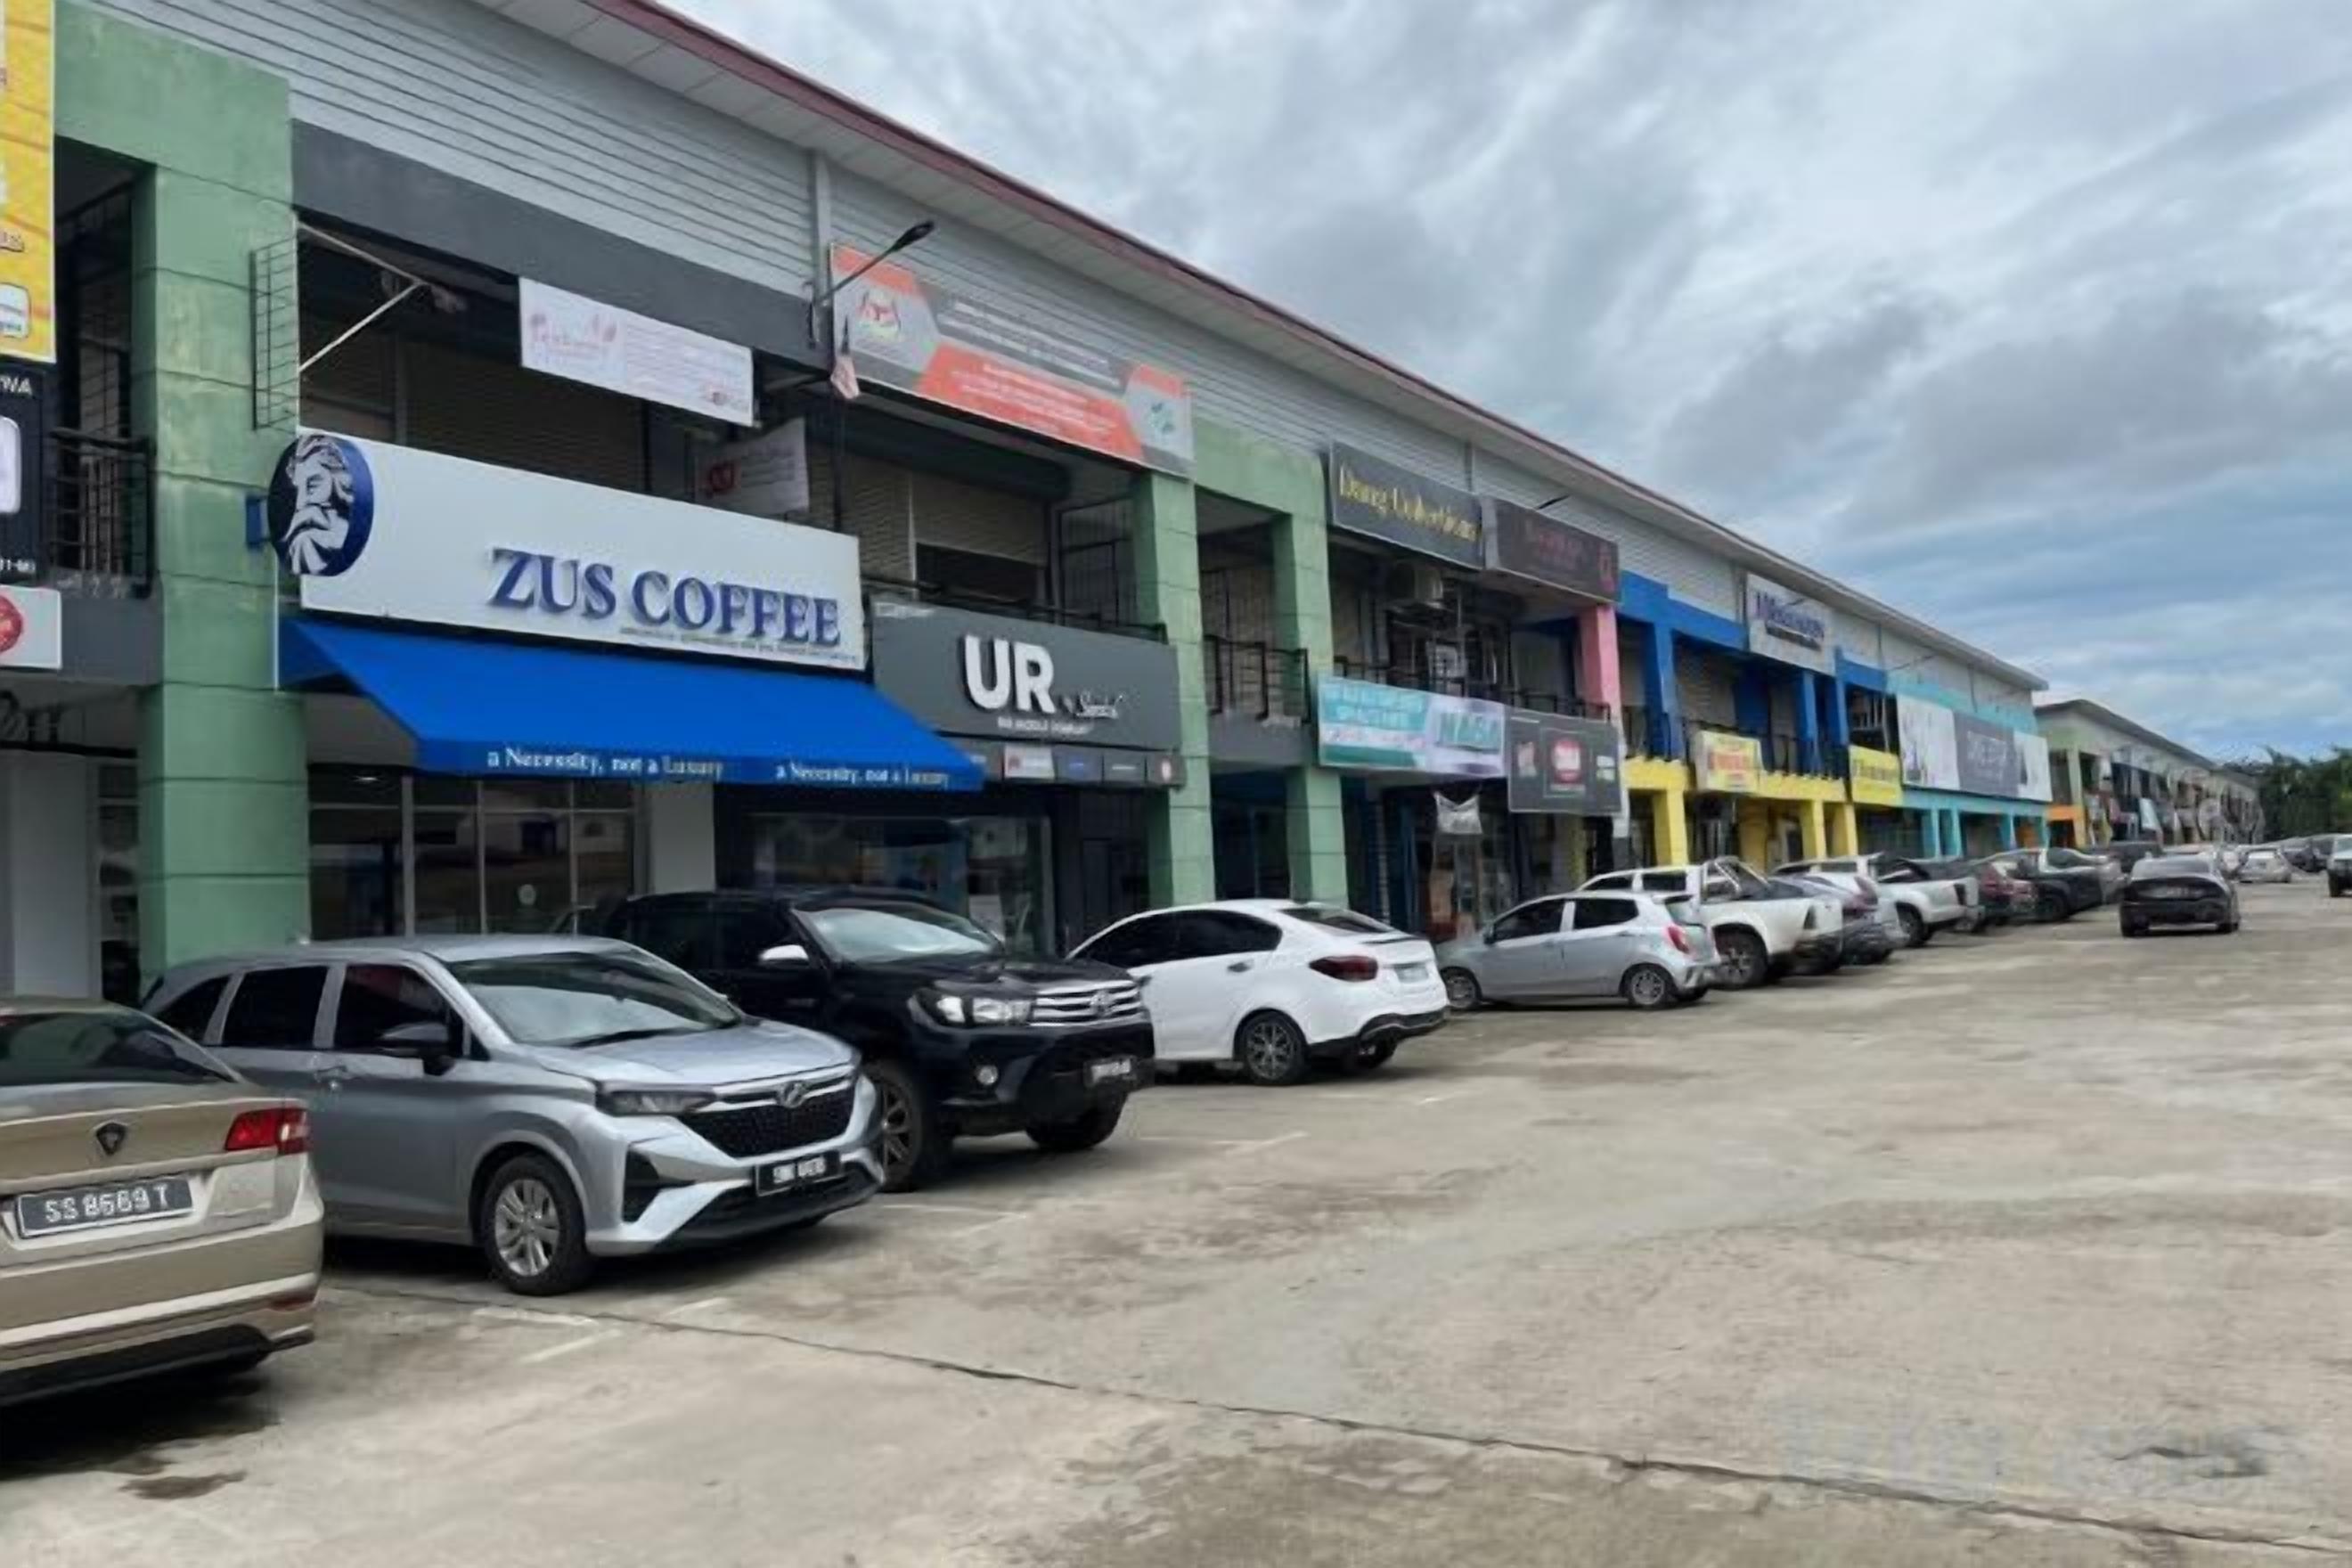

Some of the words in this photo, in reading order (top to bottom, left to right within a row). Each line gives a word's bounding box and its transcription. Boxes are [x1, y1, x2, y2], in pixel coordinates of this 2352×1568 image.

[487, 548, 617, 619] ZUS
[631, 570, 841, 648] COFFEE
[45, 1196, 78, 1223] SS
[152, 1182, 168, 1209] T
